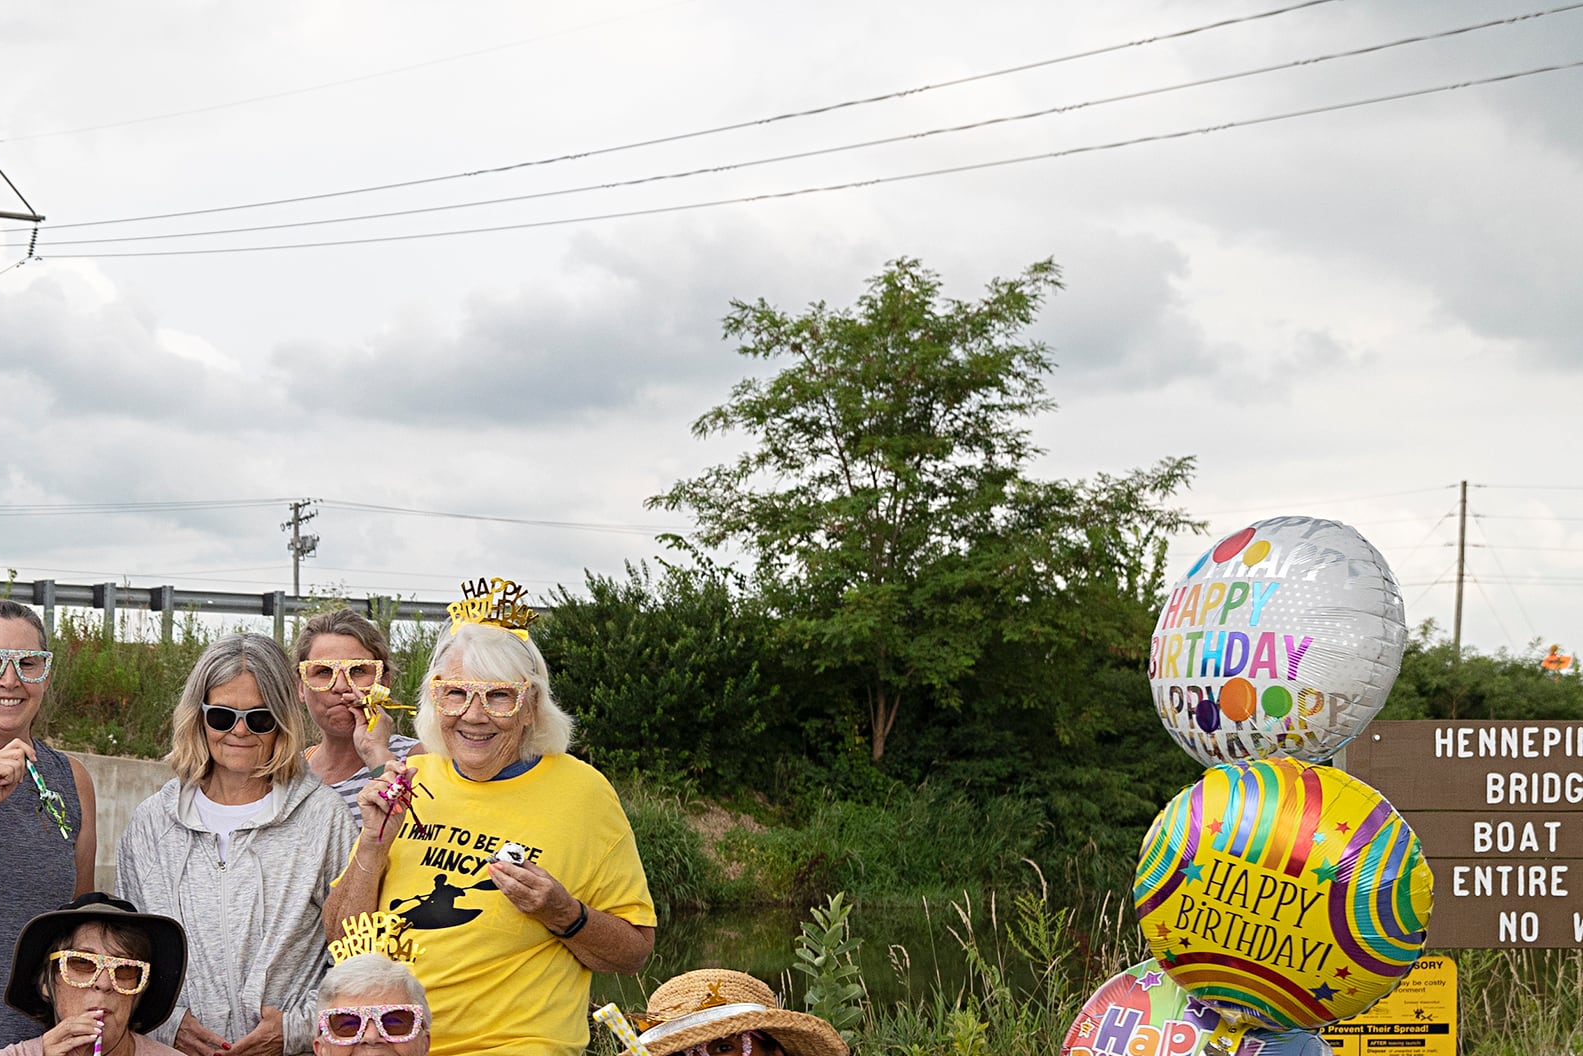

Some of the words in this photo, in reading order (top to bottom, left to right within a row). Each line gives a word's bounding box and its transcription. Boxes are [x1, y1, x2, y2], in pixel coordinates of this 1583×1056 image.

[461, 577, 528, 601] HAPPY
[447, 598, 539, 627] BIRTHDAY
[1162, 581, 1280, 630] HAPPY
[1148, 630, 1314, 681] BIRTHDAY
[1435, 727, 1583, 758] HENNEPI
[448, 827, 471, 846] TO
[473, 834, 500, 854] BE
[1474, 822, 1561, 852] BOAT
[420, 847, 488, 876] NANCY
[1203, 859, 1324, 928] HAPPY
[1453, 865, 1568, 897] ENTIRE
[1499, 911, 1539, 943] NO
[1367, 1025, 1391, 1033] Their
[1394, 1025, 1429, 1035] Spread!
